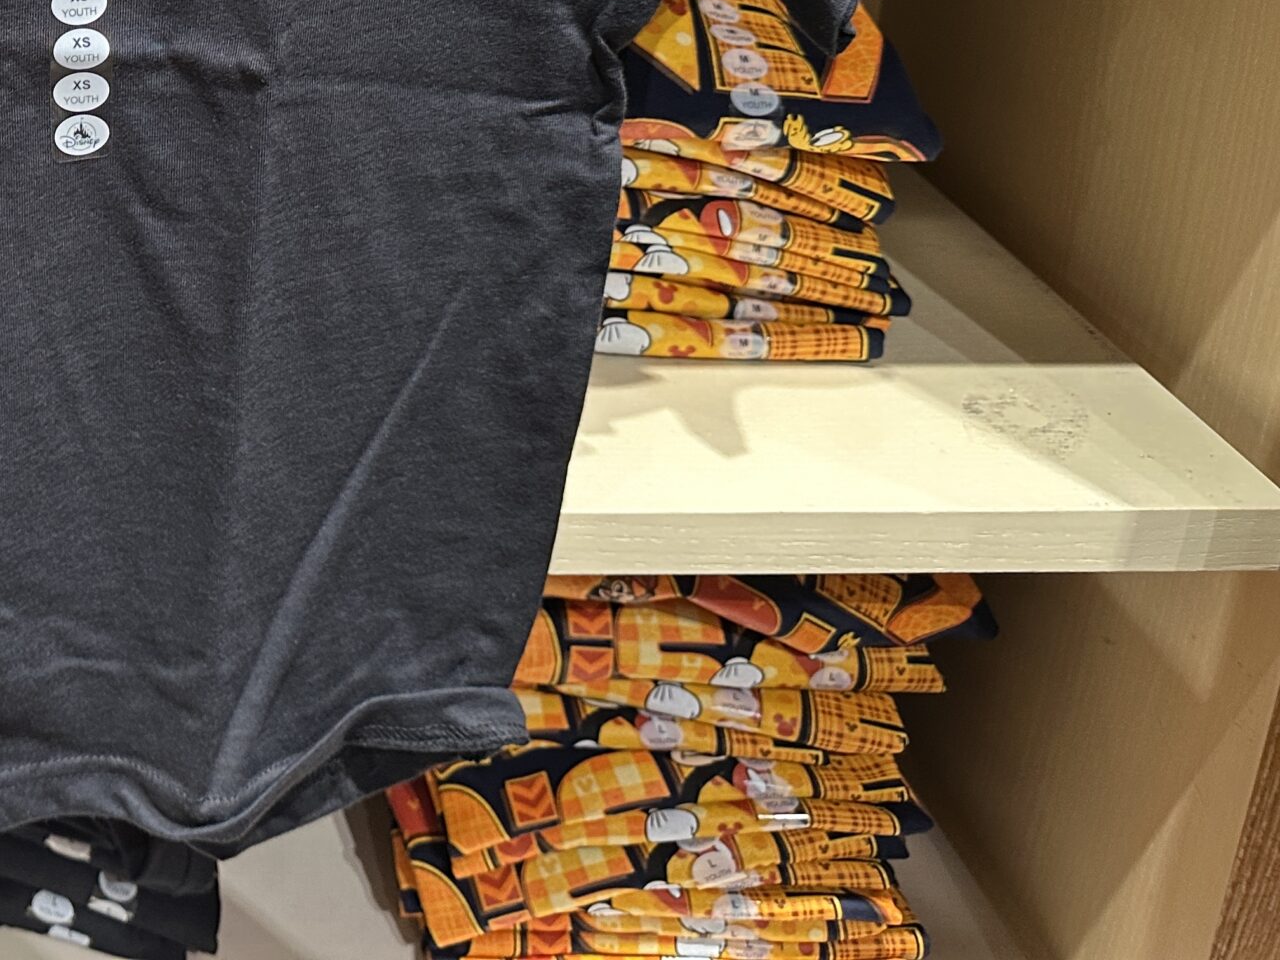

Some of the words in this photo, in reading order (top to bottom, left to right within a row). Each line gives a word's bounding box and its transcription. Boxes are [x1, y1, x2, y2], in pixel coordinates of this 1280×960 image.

[62, 7, 97, 18] YOUTH
[73, 37, 91, 49] XS
[64, 53, 99, 63] YOUTH
[73, 80, 91, 90] XS
[64, 95, 99, 106] YOUTH
[60, 135, 100, 149] Disney
